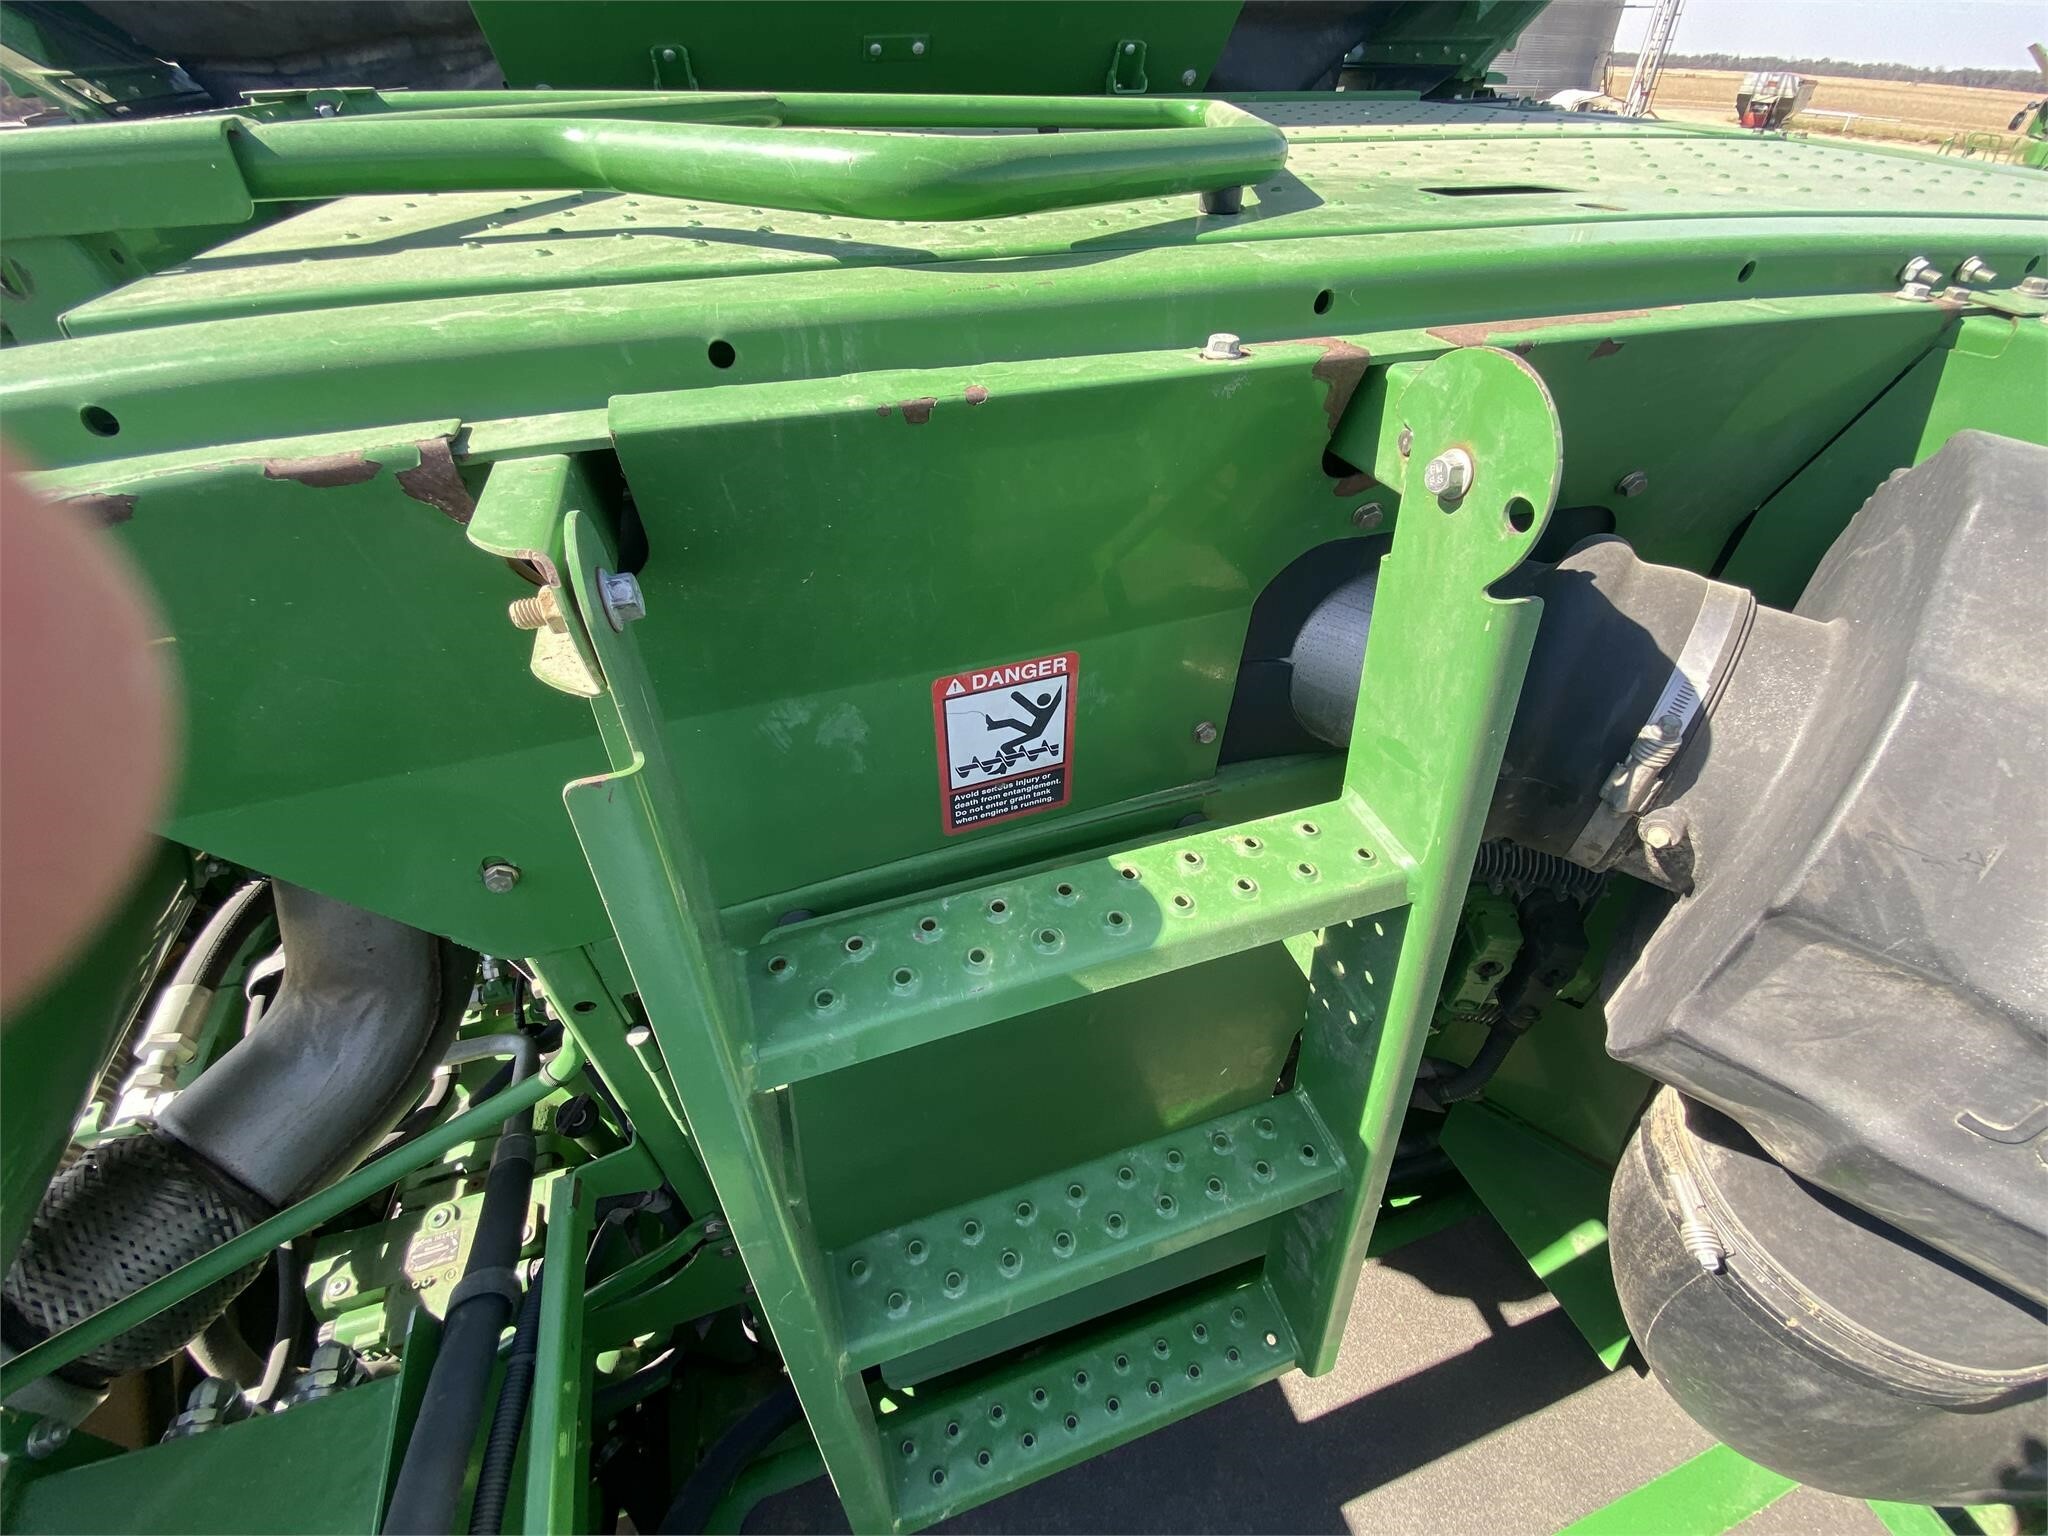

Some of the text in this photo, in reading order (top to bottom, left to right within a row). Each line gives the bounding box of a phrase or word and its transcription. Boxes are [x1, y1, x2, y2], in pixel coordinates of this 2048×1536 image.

[972, 657, 1067, 690] DANGER
[954, 790, 979, 802] Avoid
[981, 782, 1013, 795] serious
[1015, 776, 1040, 787] injury
[954, 778, 1062, 810] death from entanglement.
[969, 805, 984, 814] not
[985, 799, 1008, 810] enter
[1009, 794, 1031, 804] grain
[1033, 788, 1051, 797] tank
[955, 815, 978, 825] when
[980, 807, 1009, 819] engine
[1020, 796, 1055, 808] running.
